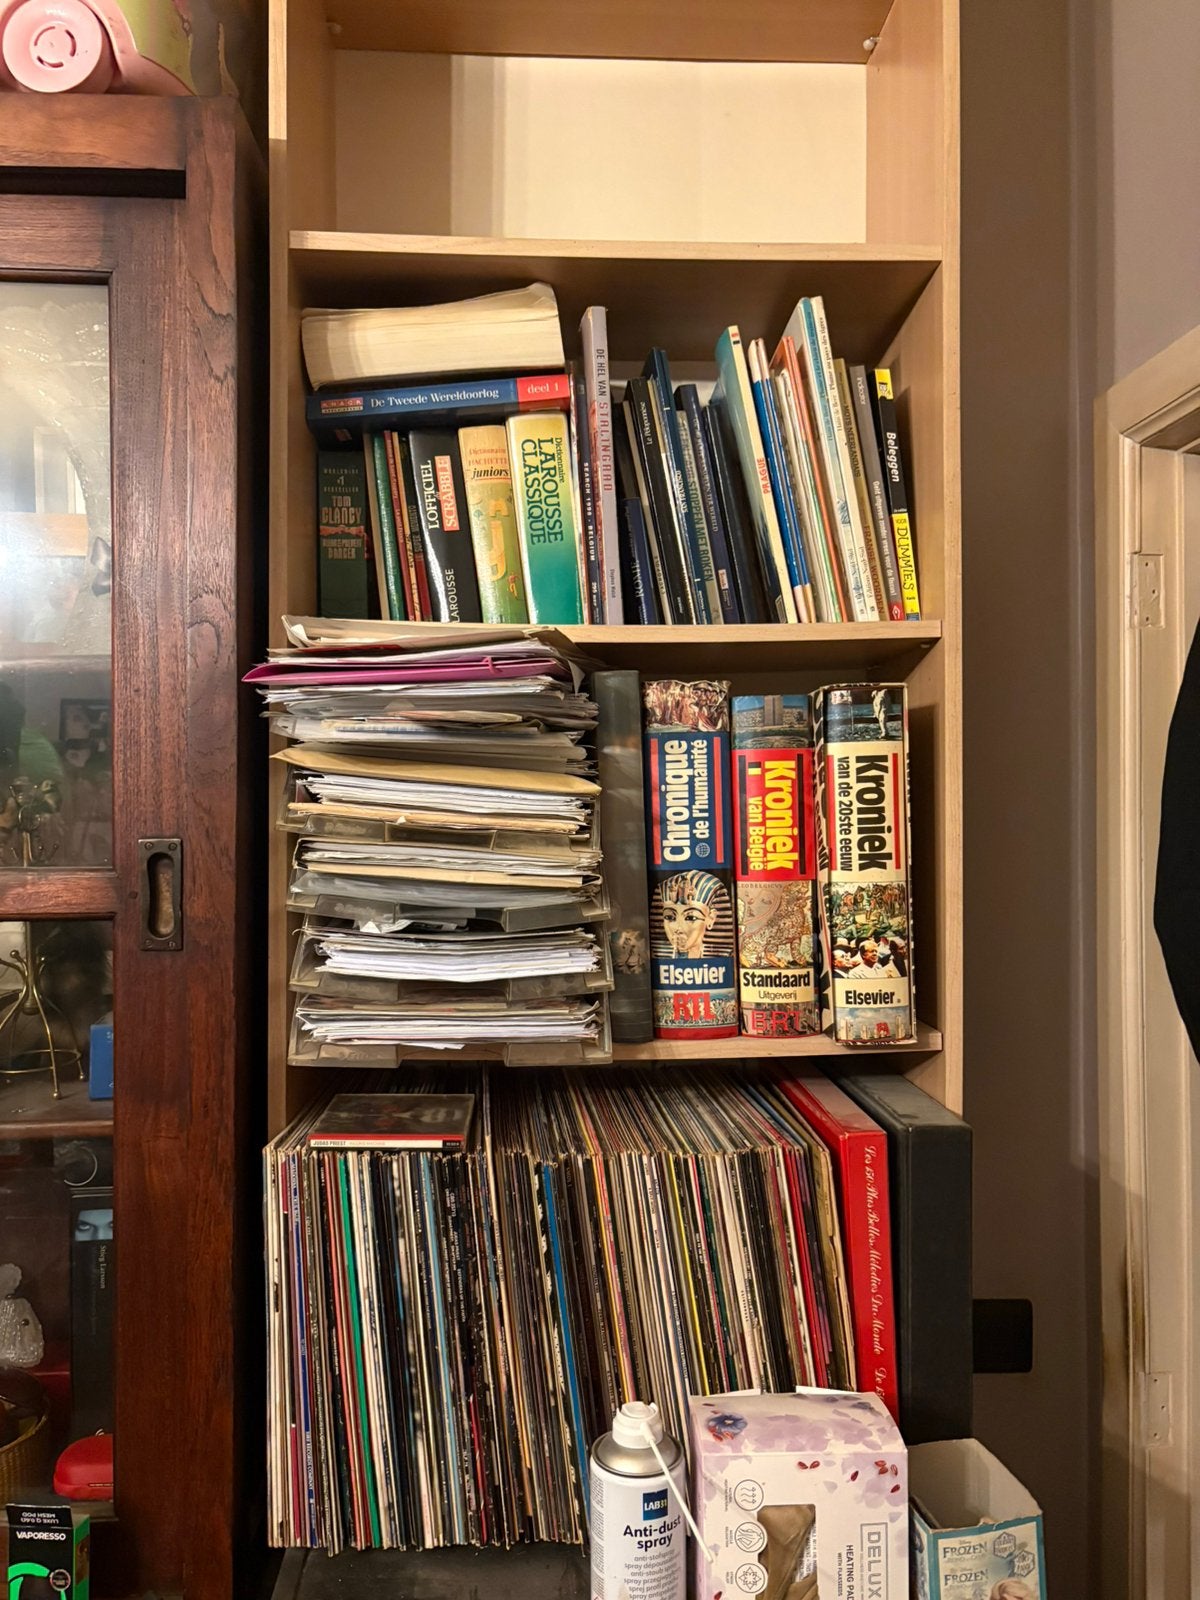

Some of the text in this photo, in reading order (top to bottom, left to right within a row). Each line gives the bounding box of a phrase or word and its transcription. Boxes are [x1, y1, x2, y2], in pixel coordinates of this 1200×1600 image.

[371, 388, 499, 408] De Tweede Wereldoorlog
[527, 382, 560, 394] deel 1
[595, 348, 613, 492] DE HEL VAN STALINGRAD
[843, 404, 852, 426] MOTS
[644, 436, 652, 445] Le
[554, 437, 566, 484] Dictionnaire
[886, 432, 899, 482] Beleggen
[472, 467, 510, 480] juniors
[757, 457, 772, 494] PRAGUE
[331, 496, 352, 507] TOM
[442, 459, 457, 528] SCRABBLE
[521, 439, 546, 546] CLASSIQUE
[537, 438, 564, 544] LAROUSSE
[686, 480, 704, 525] STOPPEN
[322, 507, 362, 524] CLANCY
[588, 524, 596, 561] BELGIUM
[694, 526, 707, 548] MET
[699, 549, 714, 582] ROKEN
[863, 524, 886, 614] FRANSE WOORDEN
[884, 555, 892, 568] voor
[886, 568, 894, 576] de
[896, 527, 914, 590] DUMMIES
[630, 559, 643, 597] ROME
[445, 568, 462, 623] LAROUSSE
[662, 739, 692, 862] Chronique
[692, 738, 709, 840] de l'humanité
[765, 760, 799, 871] Kroniek
[837, 756, 853, 872] van de 20ste eeuw
[856, 754, 893, 871] Kroniek
[748, 796, 767, 871] van België
[659, 964, 726, 985] Elsevier
[743, 970, 811, 988] Standaard
[673, 992, 717, 1022] RTL
[758, 988, 798, 1002] Uitgeverij
[845, 990, 896, 1006] Elsevier
[752, 1010, 801, 1032] BRT
[862, 1144, 890, 1370] Les 150 Plus Belles Mélodies Du Monde
[873, 1367, 888, 1384] De
[644, 1499, 668, 1511] LAB31
[16, 1530, 66, 1540] VAPORESSO
[623, 1515, 681, 1538] Anti-dust
[637, 1534, 673, 1552] spray
[943, 1542, 988, 1558] FROZEN
[846, 1544, 854, 1582] HEATING
[868, 1531, 882, 1600] DELUX
[944, 1569, 988, 1586] FROZEN
